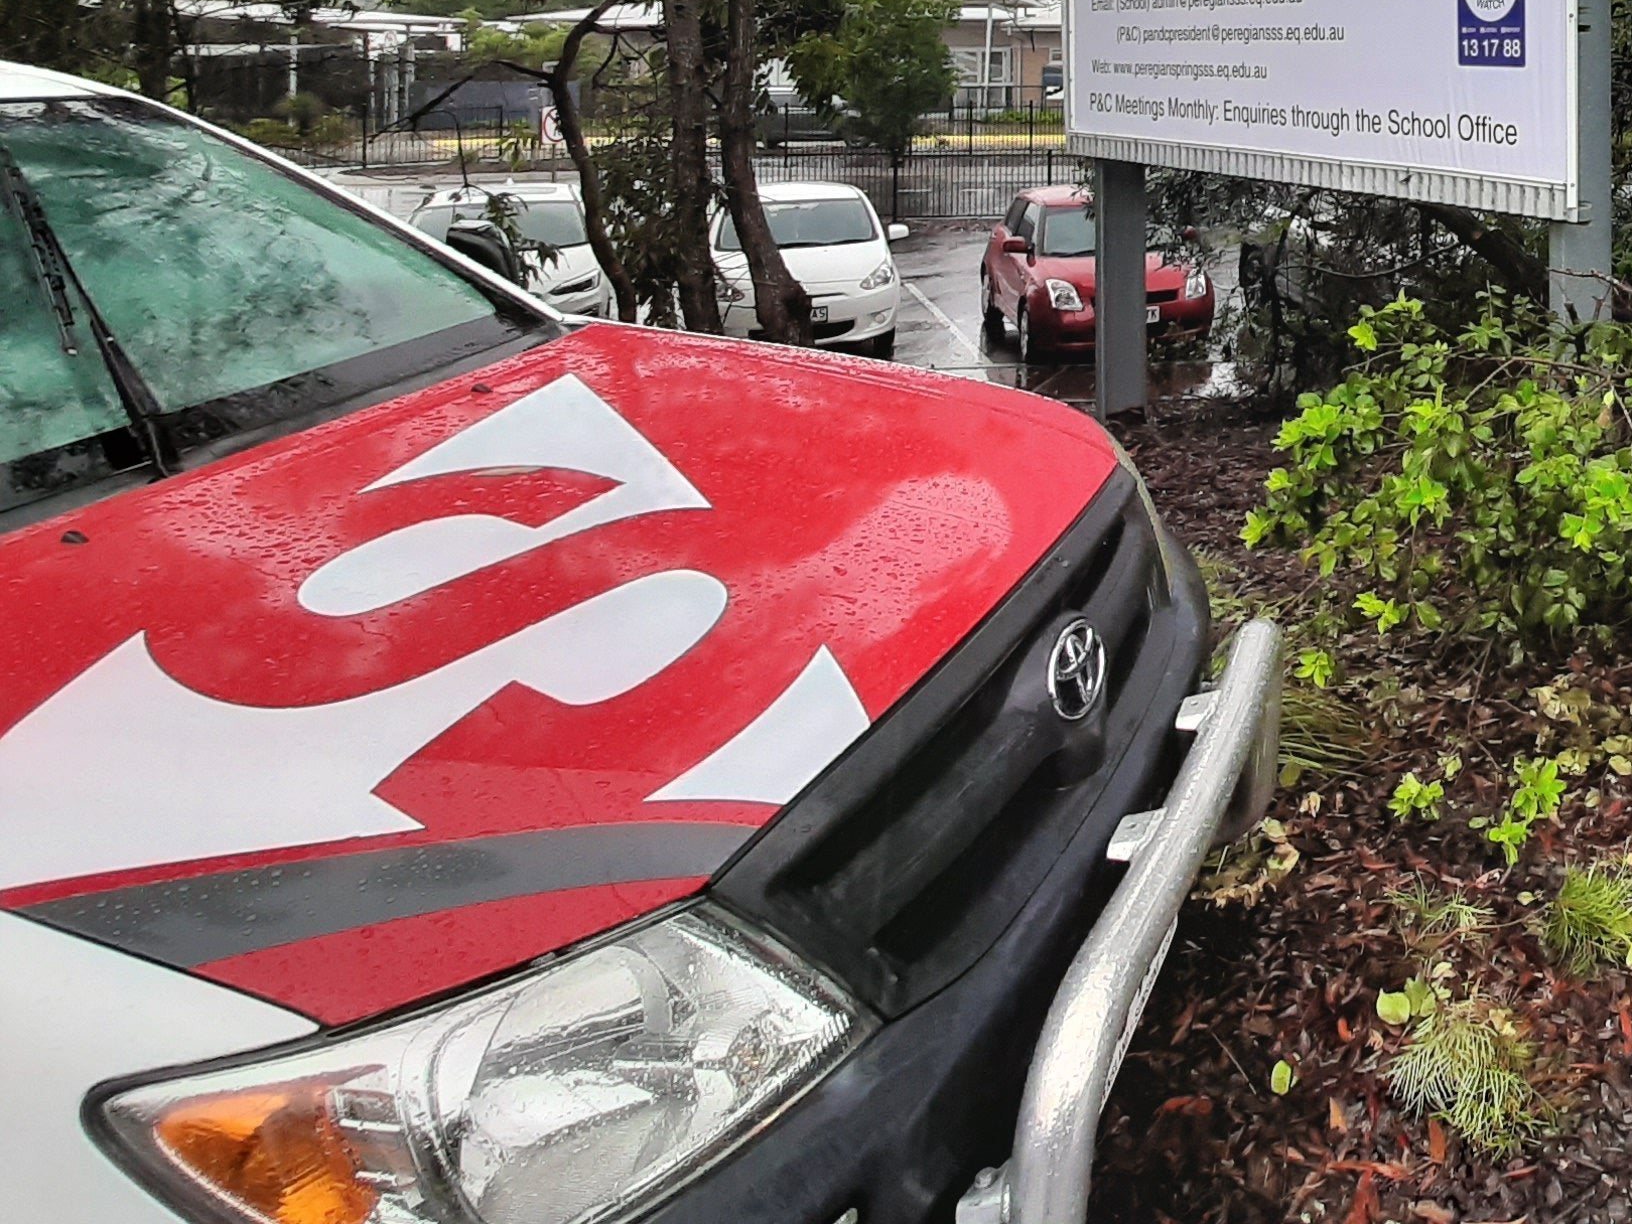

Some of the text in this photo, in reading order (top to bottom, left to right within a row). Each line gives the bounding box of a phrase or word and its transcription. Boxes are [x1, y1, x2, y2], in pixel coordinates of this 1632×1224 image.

[1116, 26, 1141, 44] (P&C)
[1462, 39, 1521, 58] 13 17 88
[1091, 59, 1112, 74] Web:
[1090, 92, 1518, 145] P&C Meetings Monthly: Enquiries through the School Office
